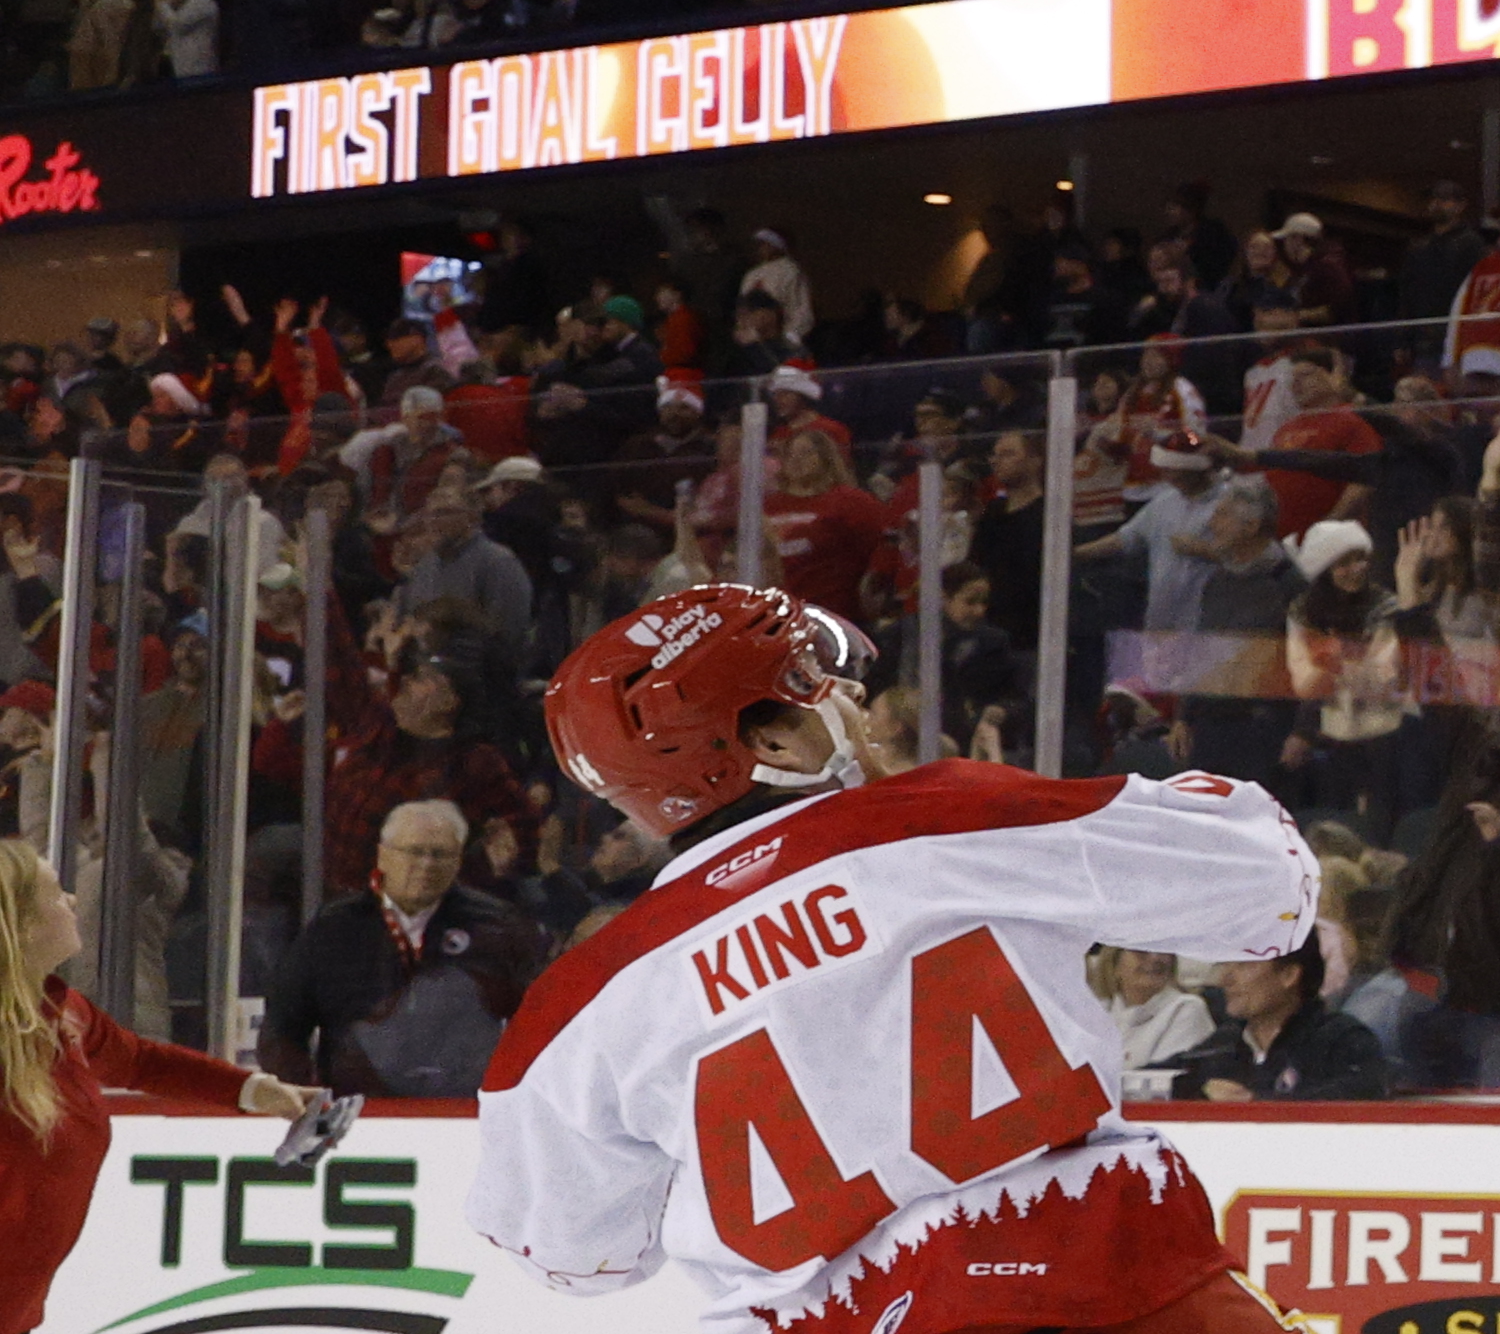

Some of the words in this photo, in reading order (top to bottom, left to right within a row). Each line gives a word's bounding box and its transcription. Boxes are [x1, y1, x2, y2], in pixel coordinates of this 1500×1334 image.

[252, 67, 431, 199] FIRST
[448, 46, 617, 177] GOAL
[637, 14, 848, 153] CELLY
[651, 612, 723, 670] alberta
[661, 603, 707, 640] play
[705, 836, 784, 887] CCM
[691, 883, 868, 1016] KING
[694, 925, 1111, 1273] 44
[130, 1155, 417, 1270] TCS
[966, 1262, 1048, 1277] CCM
